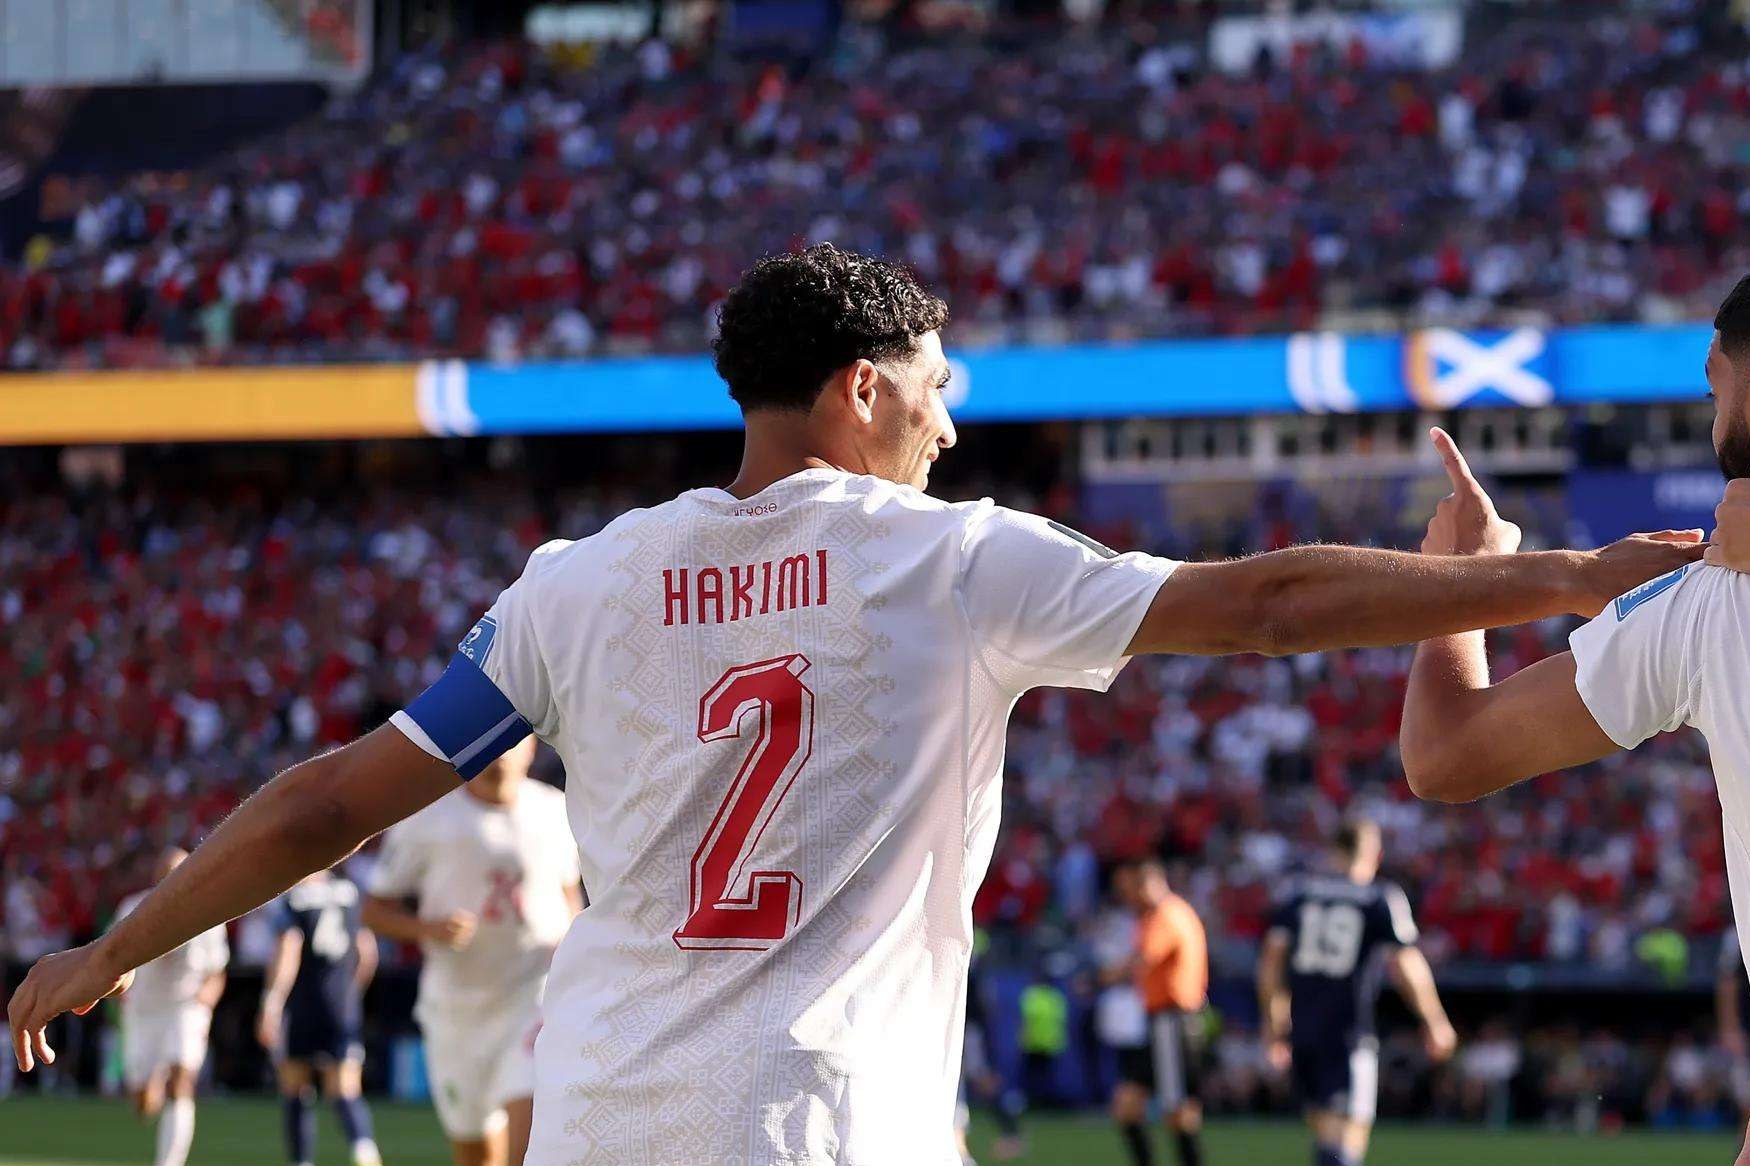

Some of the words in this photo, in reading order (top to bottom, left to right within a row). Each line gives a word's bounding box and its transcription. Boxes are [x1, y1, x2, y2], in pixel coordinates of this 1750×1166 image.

[662, 549, 827, 626] HAKIMI
[671, 652, 815, 951] 2
[1293, 901, 1367, 979] 19
